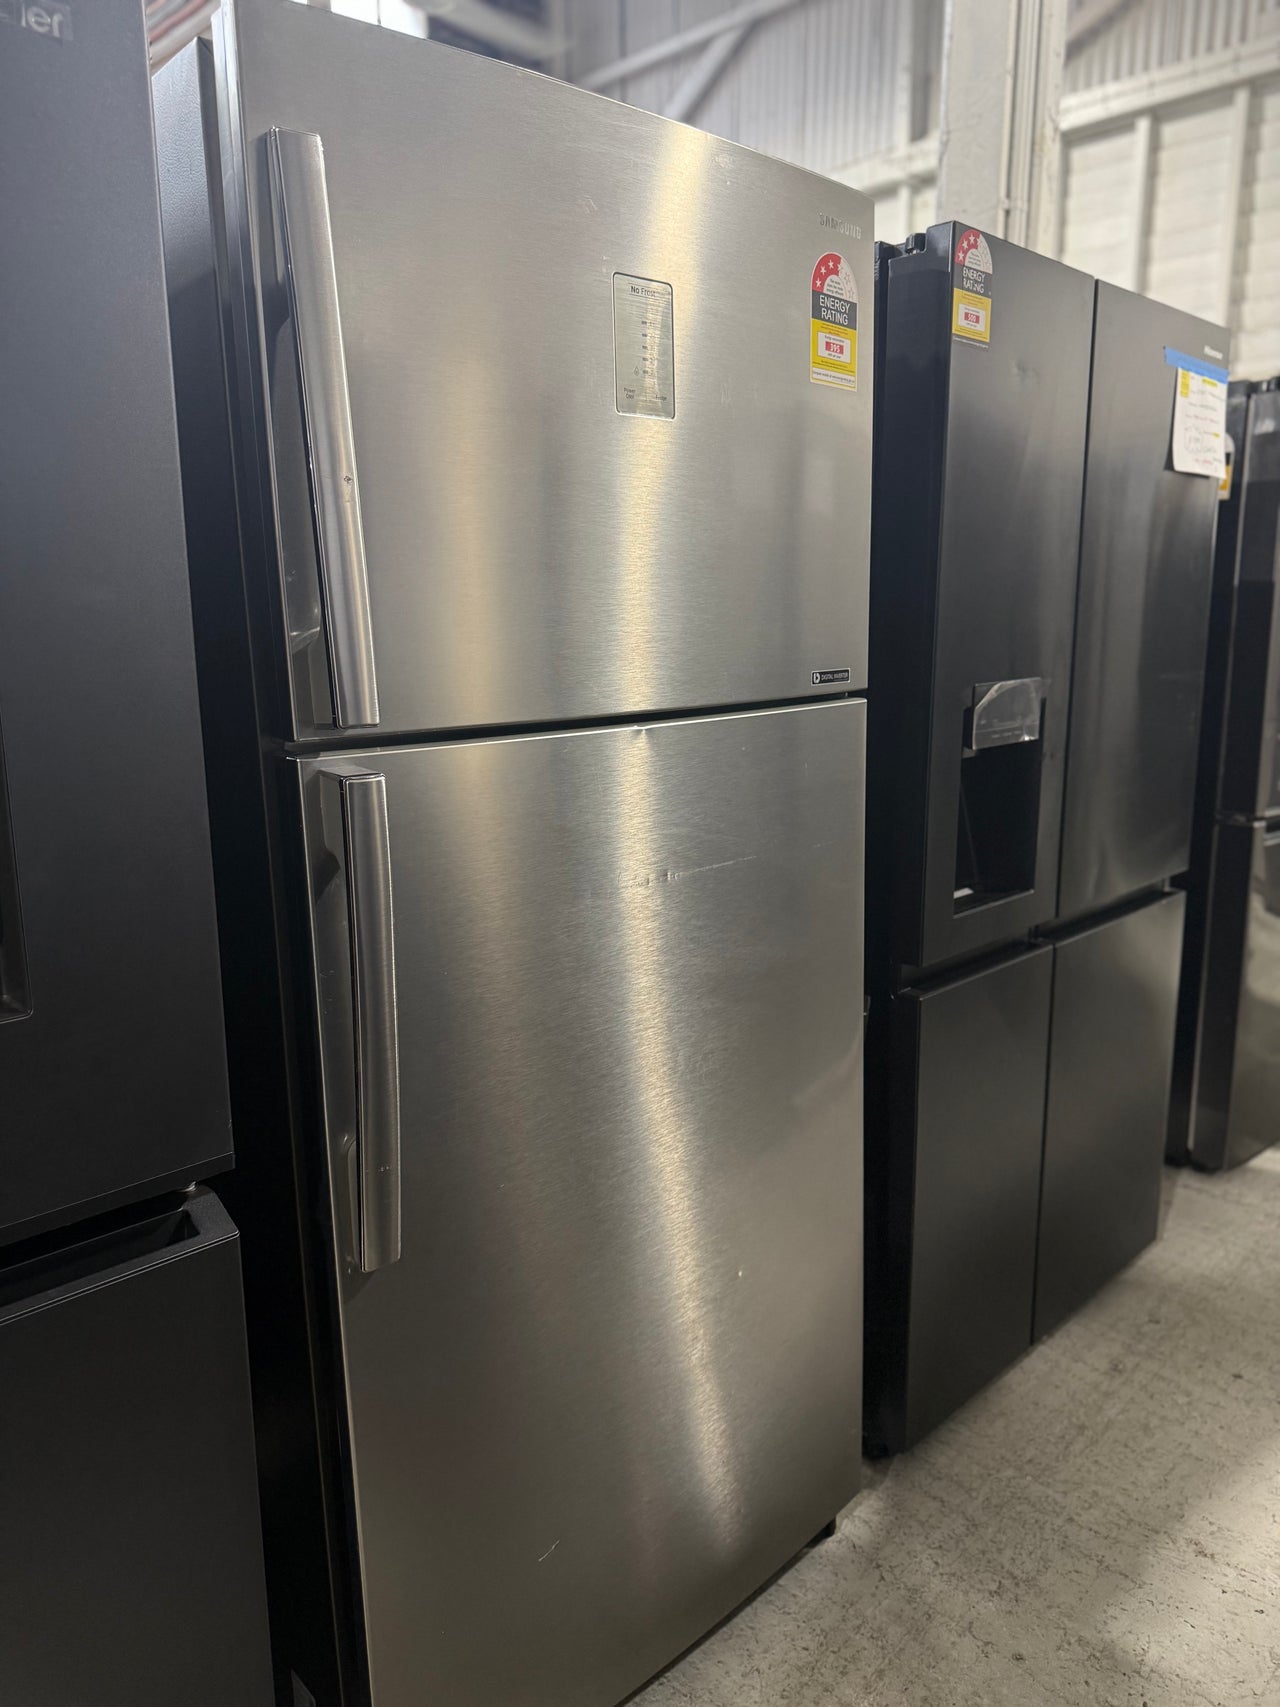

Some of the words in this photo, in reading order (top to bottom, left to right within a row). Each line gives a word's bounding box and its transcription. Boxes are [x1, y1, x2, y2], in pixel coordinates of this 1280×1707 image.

[819, 213, 862, 240] SAMSUNG
[963, 267, 985, 283] ENERGY
[630, 285, 640, 295] No
[963, 278, 985, 294] RATING
[819, 295, 851, 314] ENERGY
[821, 308, 849, 326] RATING
[830, 343, 841, 354] 395
